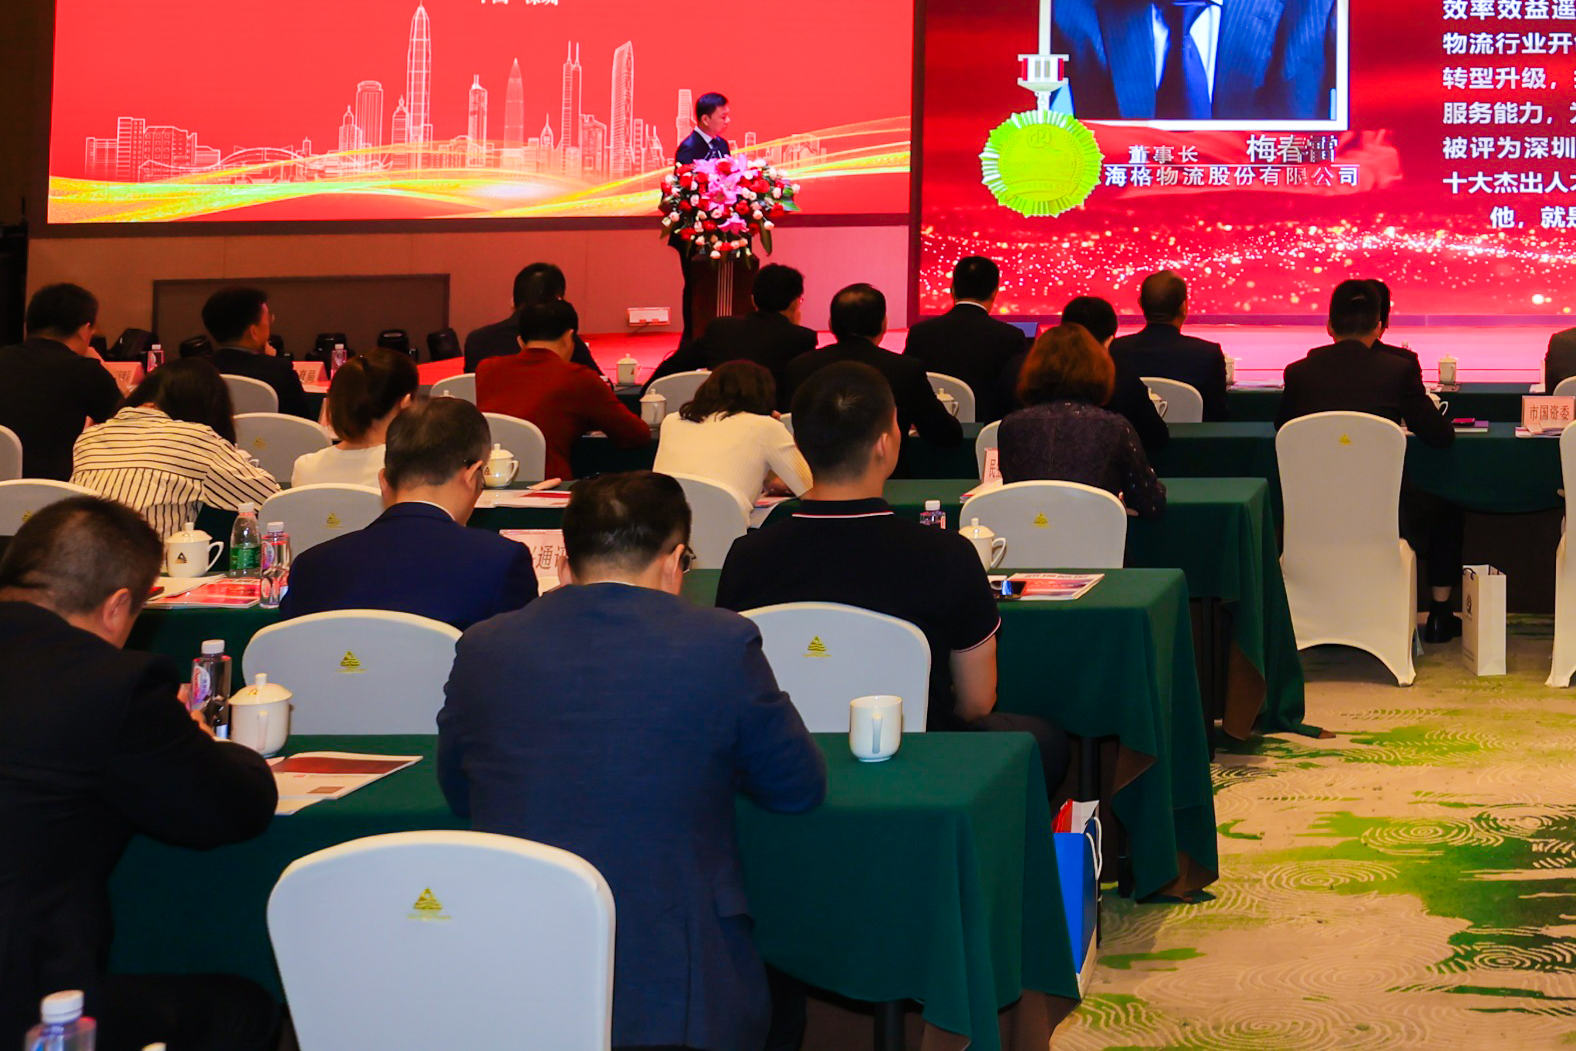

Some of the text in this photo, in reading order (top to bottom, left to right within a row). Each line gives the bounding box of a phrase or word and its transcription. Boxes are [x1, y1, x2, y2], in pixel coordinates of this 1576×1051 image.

[1128, 144, 1199, 164] 董事长
[1104, 166, 1359, 187] 海格物流股份有限公司
[1529, 404, 1570, 421] 市国资委
